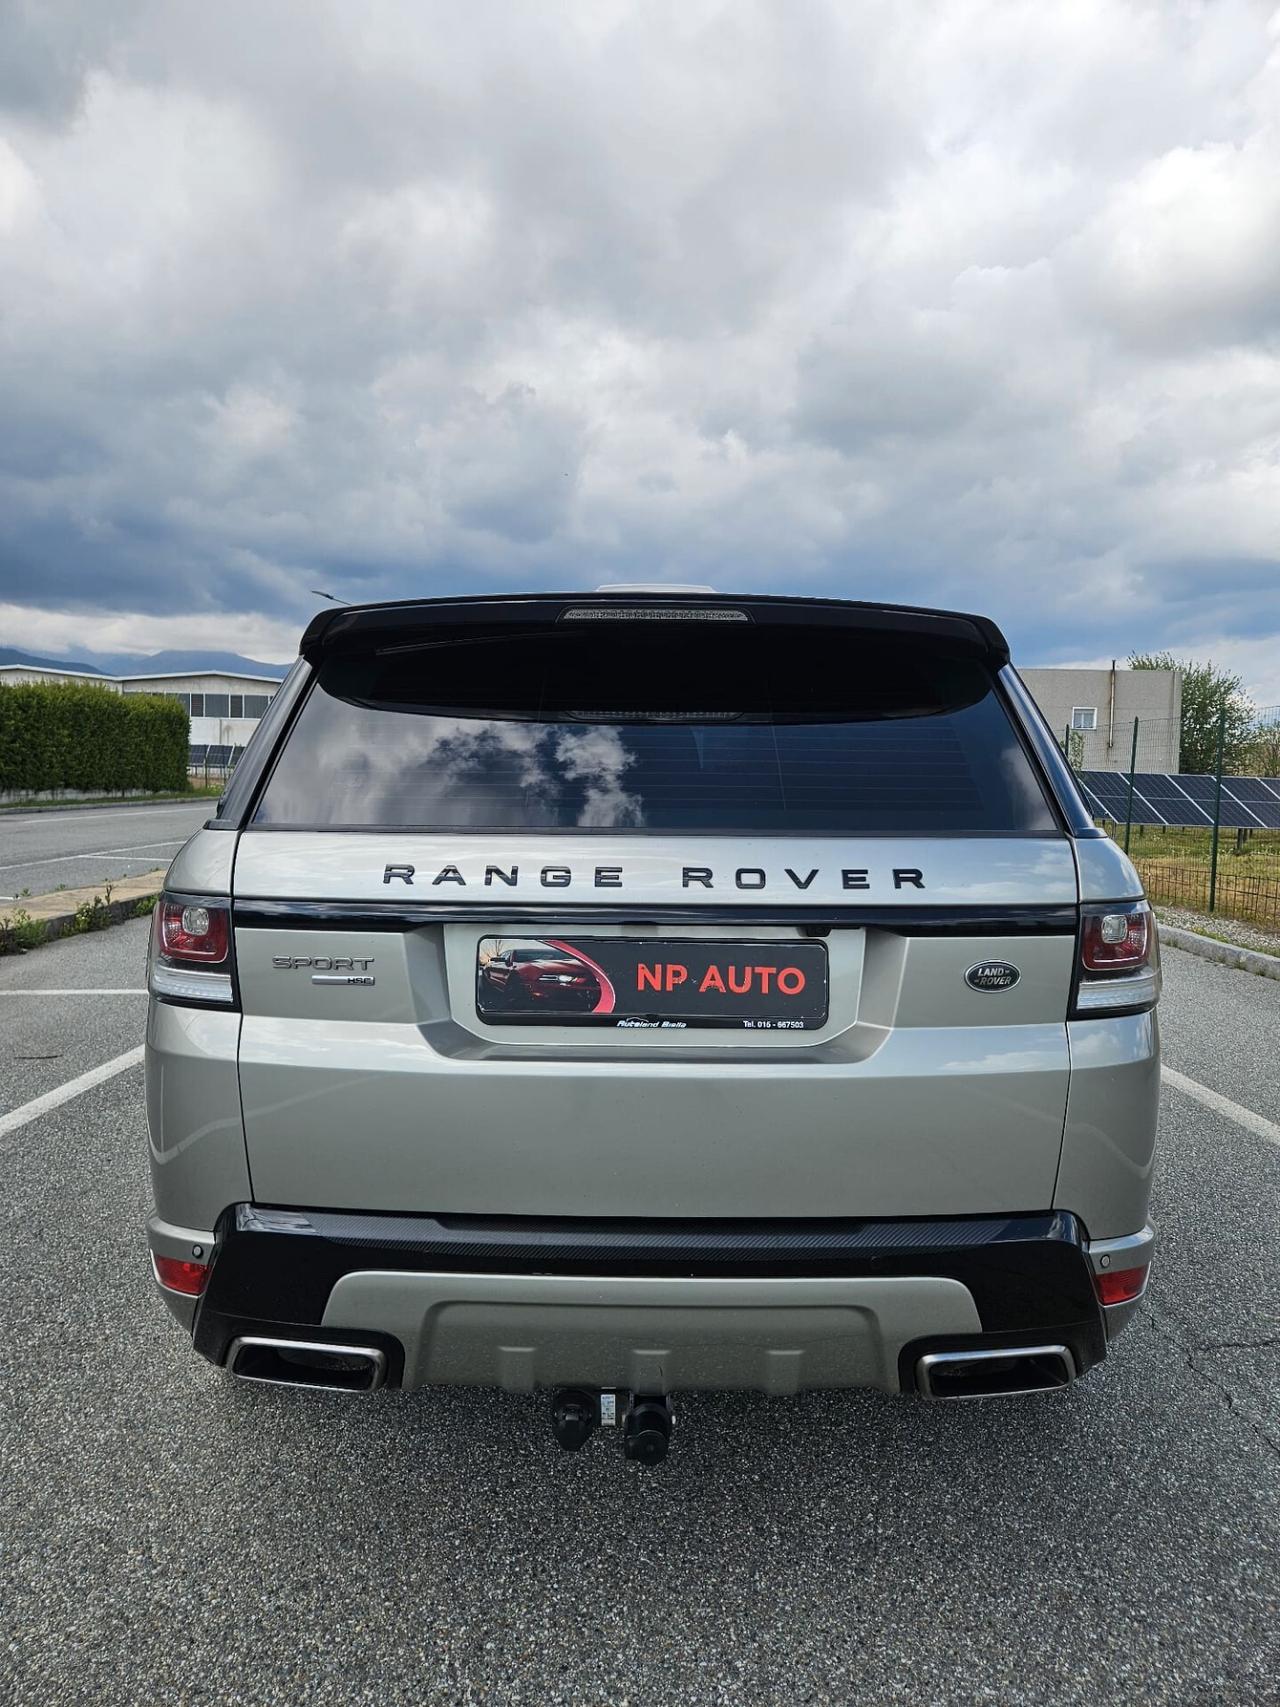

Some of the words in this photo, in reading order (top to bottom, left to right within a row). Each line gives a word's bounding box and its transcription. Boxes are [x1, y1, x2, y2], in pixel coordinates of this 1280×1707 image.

[382, 863, 623, 888] RANGE
[682, 866, 926, 890] ROVER
[271, 954, 375, 972] SPORT
[637, 962, 688, 992] NP
[699, 964, 806, 995] AUTO
[742, 1020, 756, 1029] Tel.
